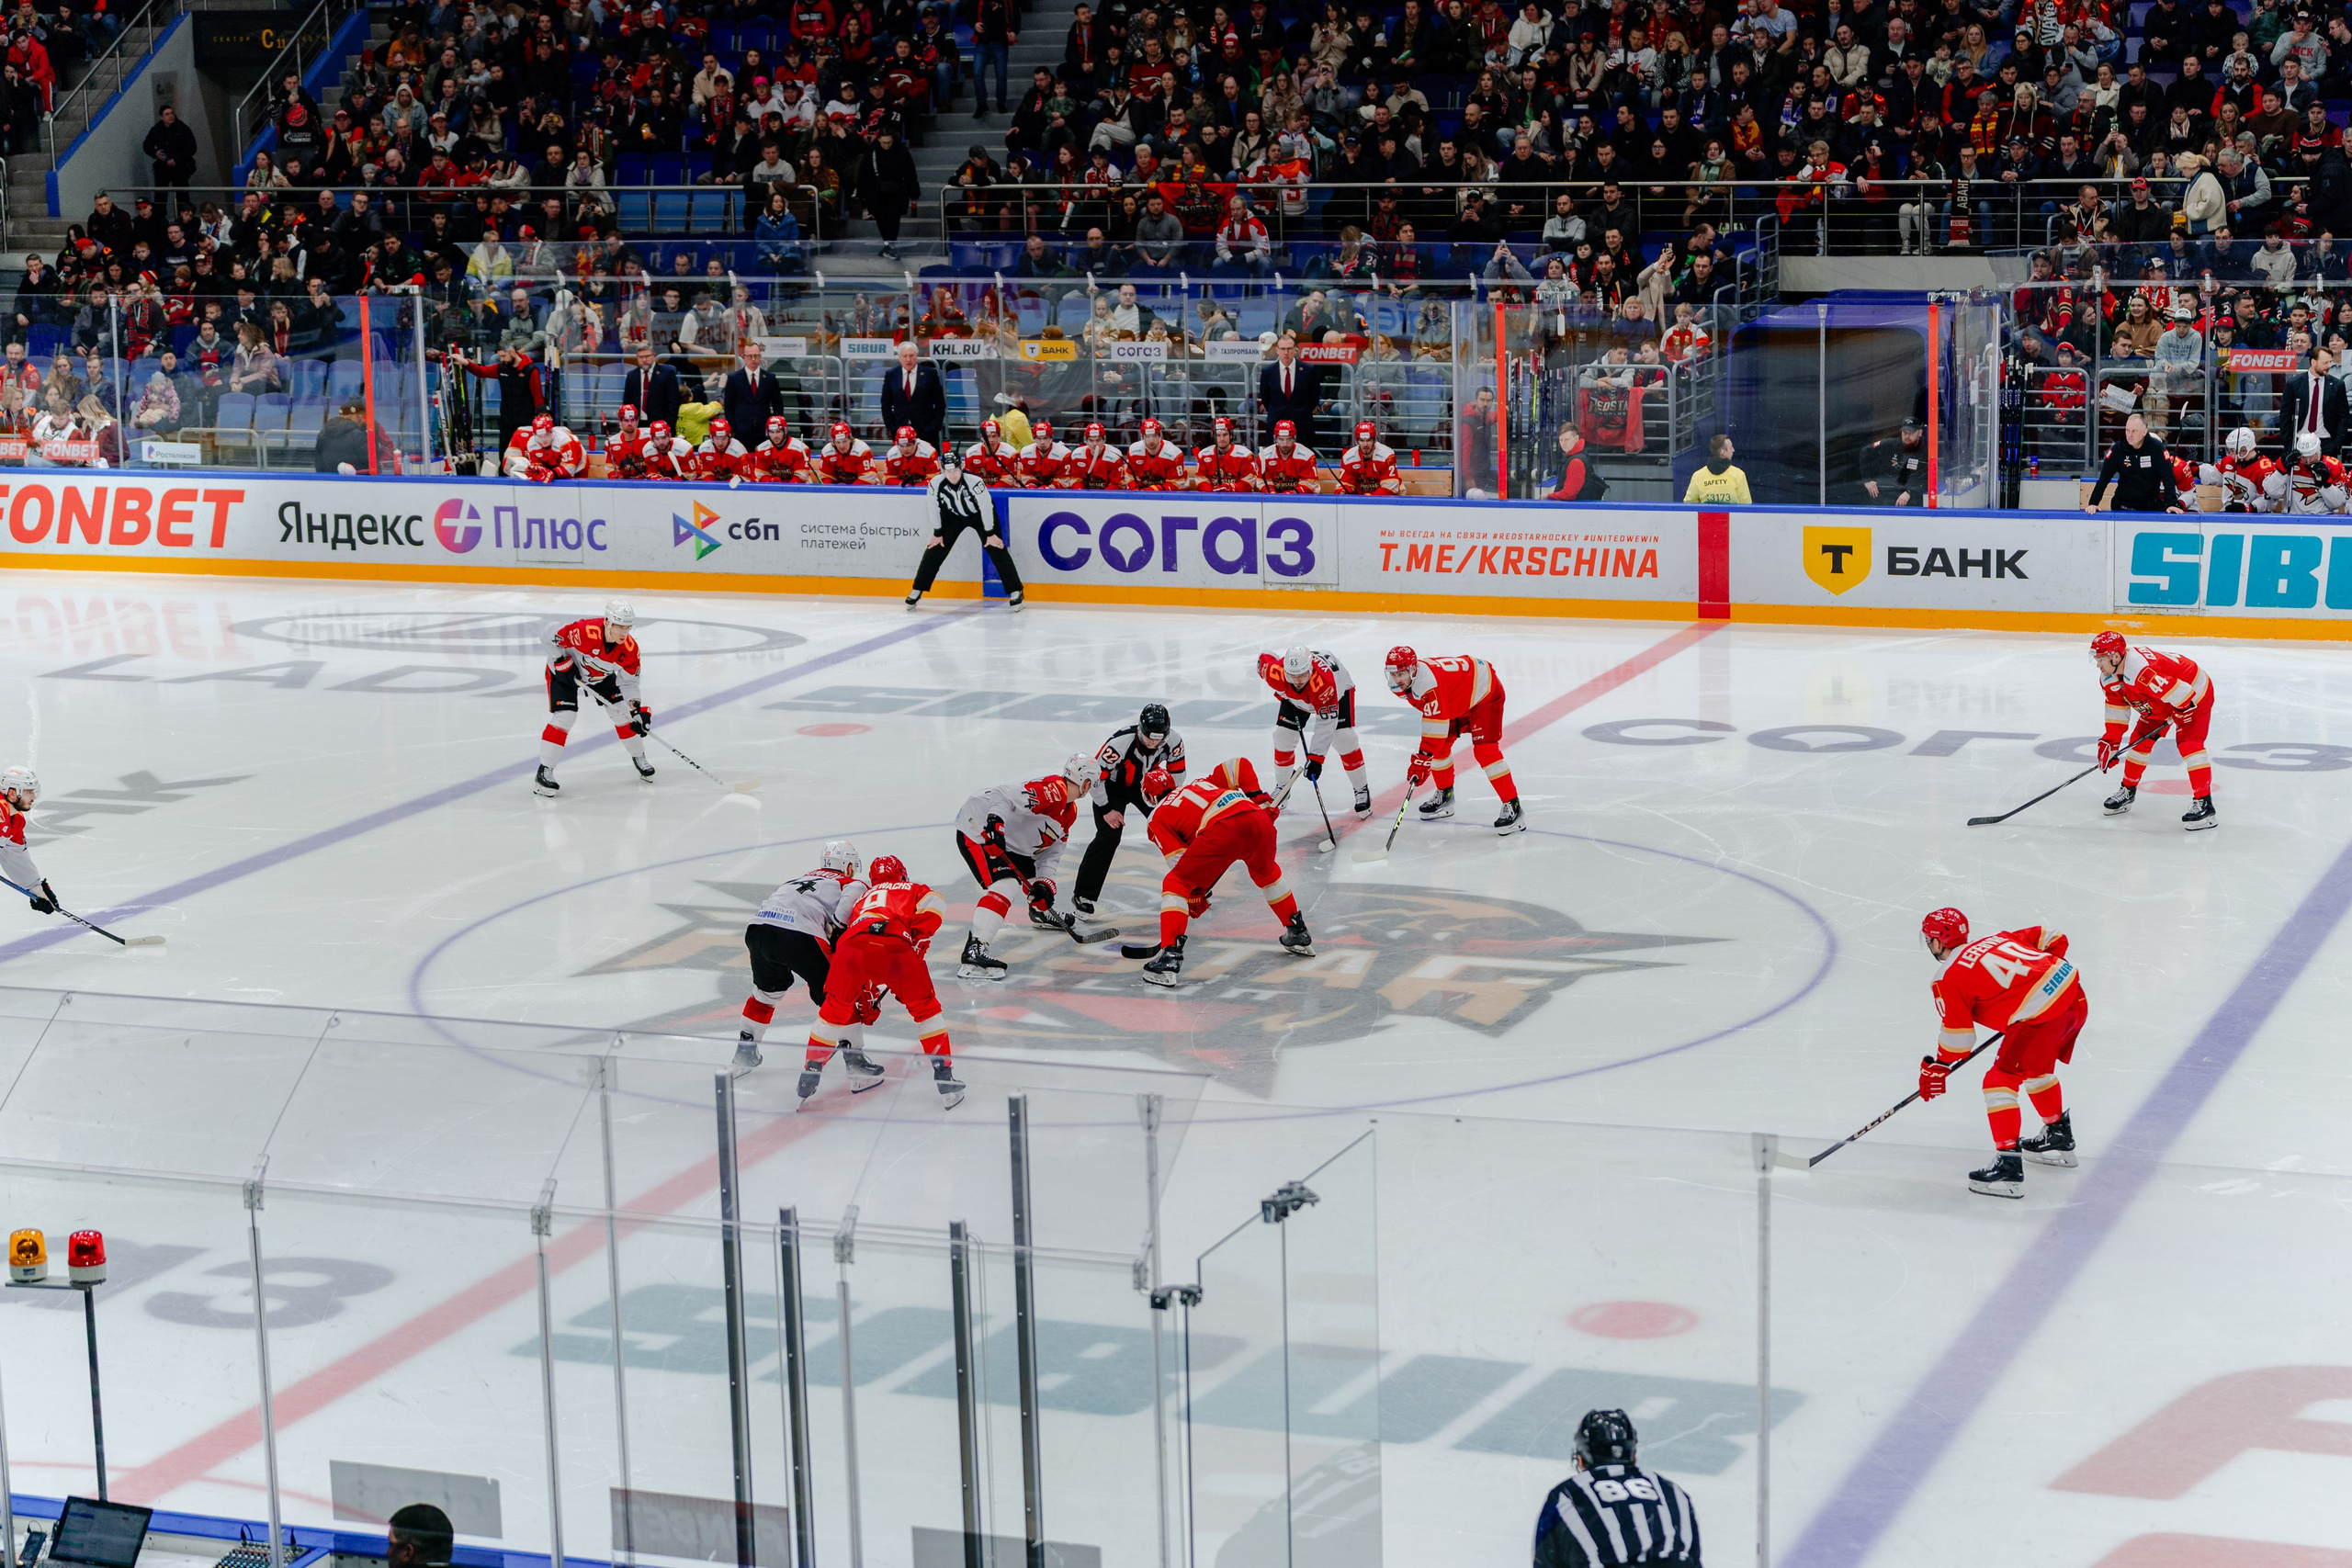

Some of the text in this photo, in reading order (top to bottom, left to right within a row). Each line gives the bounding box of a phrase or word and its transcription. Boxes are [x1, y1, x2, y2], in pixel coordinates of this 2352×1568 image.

[847, 343, 888, 354] SIBUR
[933, 344, 981, 355] KHL.RU
[1041, 346, 1069, 355] БАНК
[1300, 346, 1356, 359] FONBET
[2231, 354, 2296, 368] FONBET
[42, 441, 99, 458] FONBET
[155, 450, 197, 459] Ростелеком
[1703, 479, 1727, 488] SAFETY
[277, 501, 608, 551] Яндекс Плюс
[728, 517, 780, 542] сбп
[800, 523, 921, 539] система быстрых
[800, 537, 866, 550] платежей
[1399, 530, 1435, 539] ВСЕГДА
[1440, 531, 1453, 539] НА
[1456, 531, 1488, 540] СВЯЗИ
[1492, 532, 1579, 542] #REDSTARHOCKEY
[1583, 534, 1660, 543] #UNITEDWEWIN
[1379, 543, 1659, 579] T.ME/KRSCHINA
[1887, 547, 2030, 581] БАНК
[36, 653, 548, 698] LAD
[2149, 674, 2170, 694] 44
[1318, 705, 1339, 720] 65
[1423, 700, 1442, 716] 92
[1102, 746, 1120, 764] 22
[1021, 787, 1041, 810] 74
[823, 858, 831, 868] 14
[859, 889, 888, 915] 9
[1979, 941, 2052, 989] 40
[2042, 962, 2074, 996] SIBUR
[1592, 1477, 1659, 1503] 86
